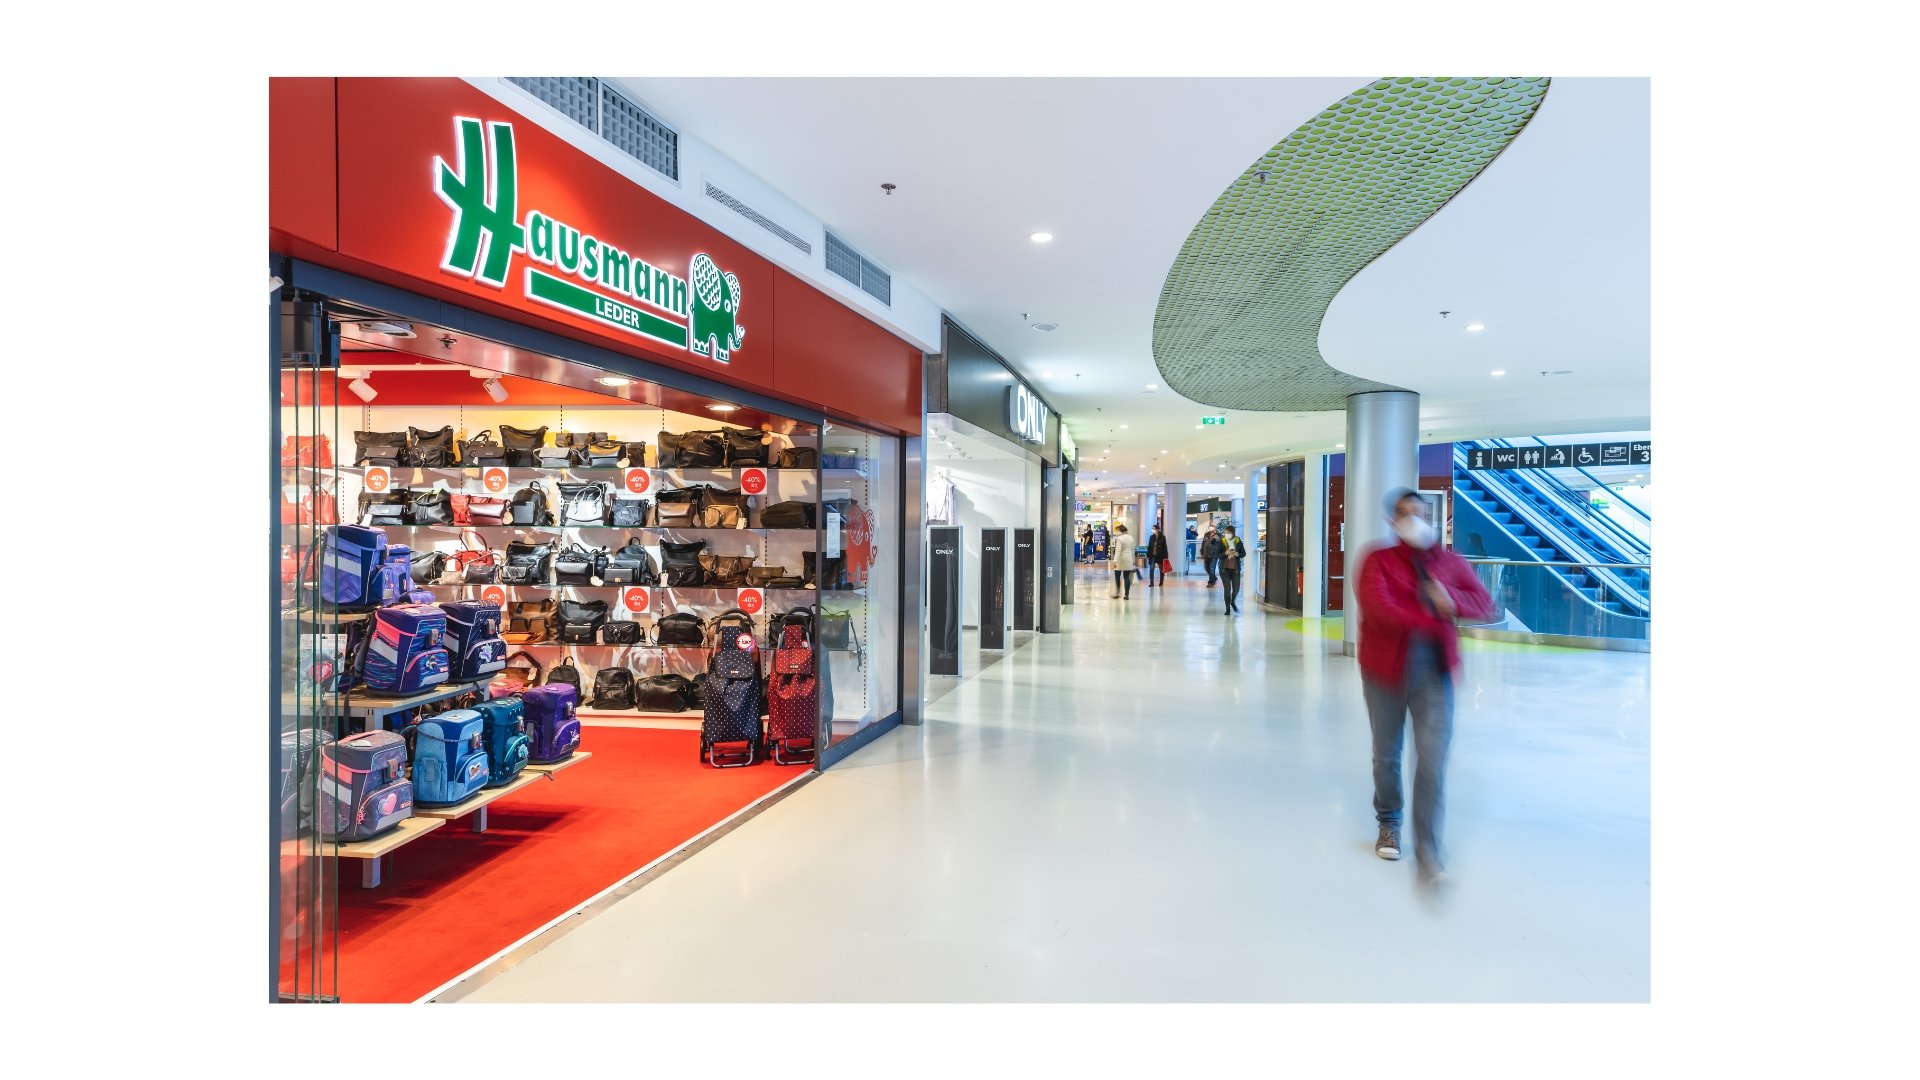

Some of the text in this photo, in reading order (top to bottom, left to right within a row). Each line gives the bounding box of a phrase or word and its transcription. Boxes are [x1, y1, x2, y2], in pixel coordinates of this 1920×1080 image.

[435, 116, 688, 318] Hausmann
[595, 298, 640, 329] LEDER
[1016, 385, 1047, 445] ONLY
[1497, 454, 1515, 463] WC
[1640, 451, 1650, 462] 3
